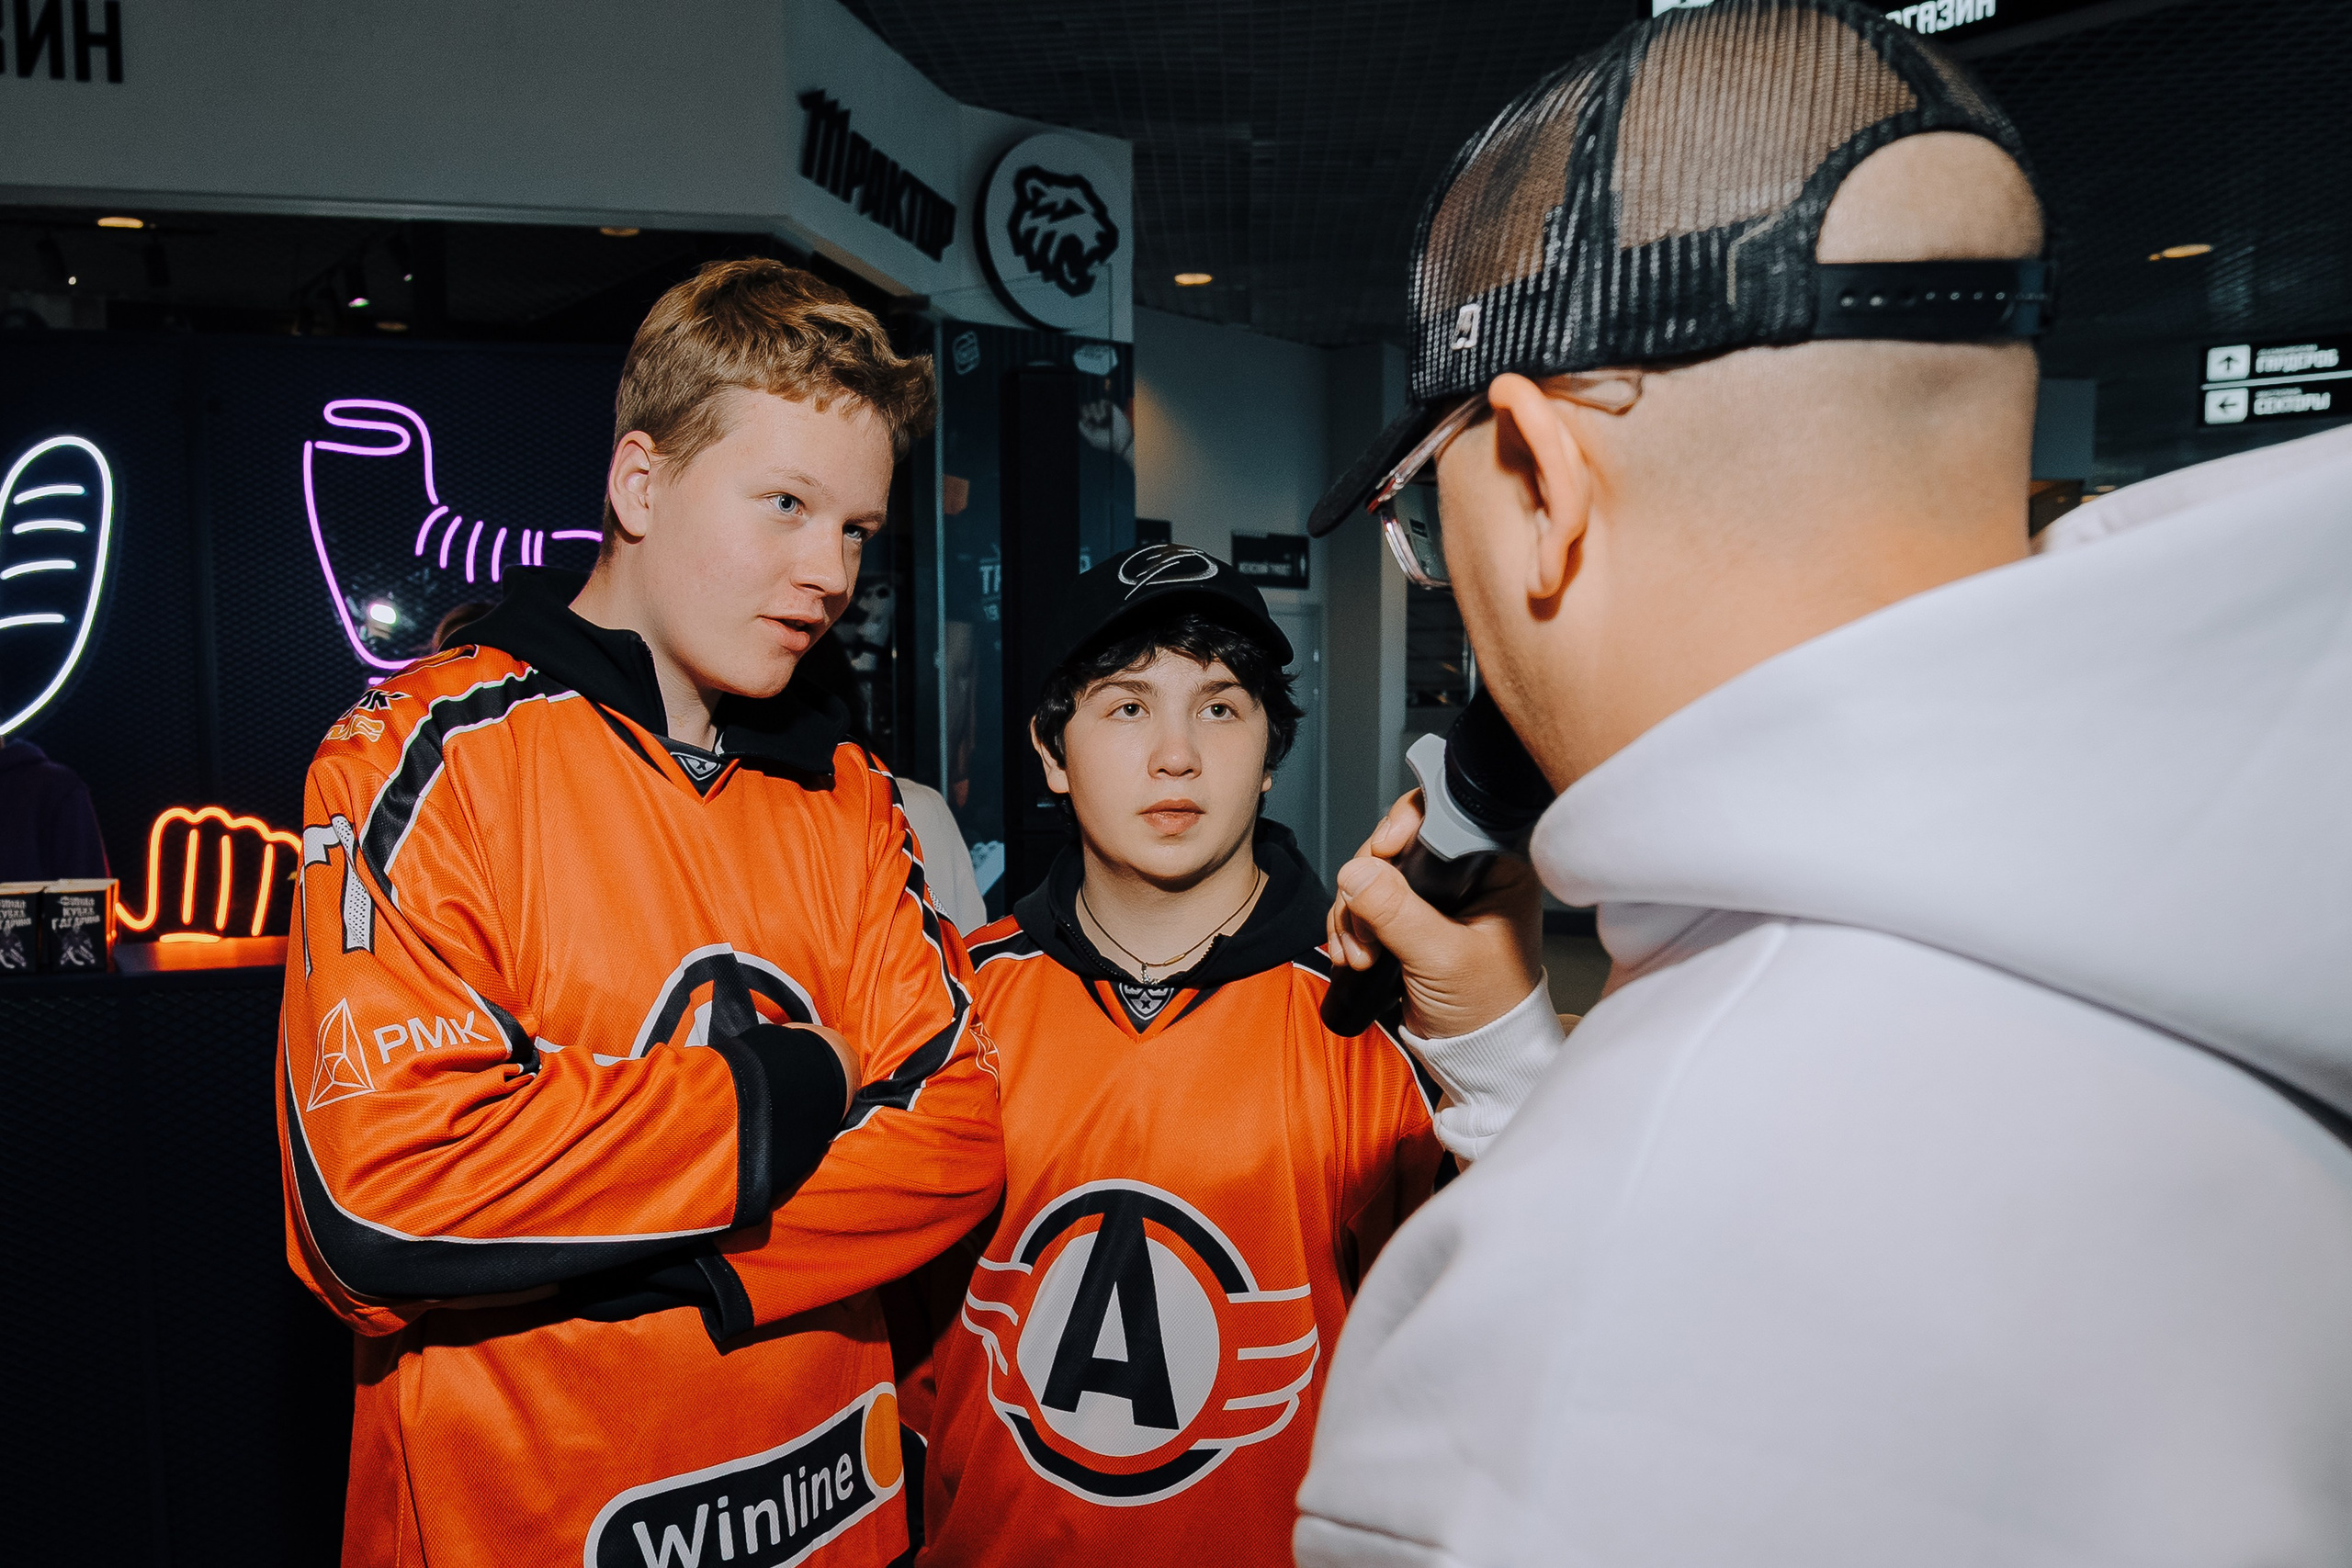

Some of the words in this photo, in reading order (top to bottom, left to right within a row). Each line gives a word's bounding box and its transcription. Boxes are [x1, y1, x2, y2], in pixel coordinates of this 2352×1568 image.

[0, 0, 123, 84] ИН
[799, 89, 956, 262] ТРАКТОР
[632, 1452, 854, 1568] Winline
